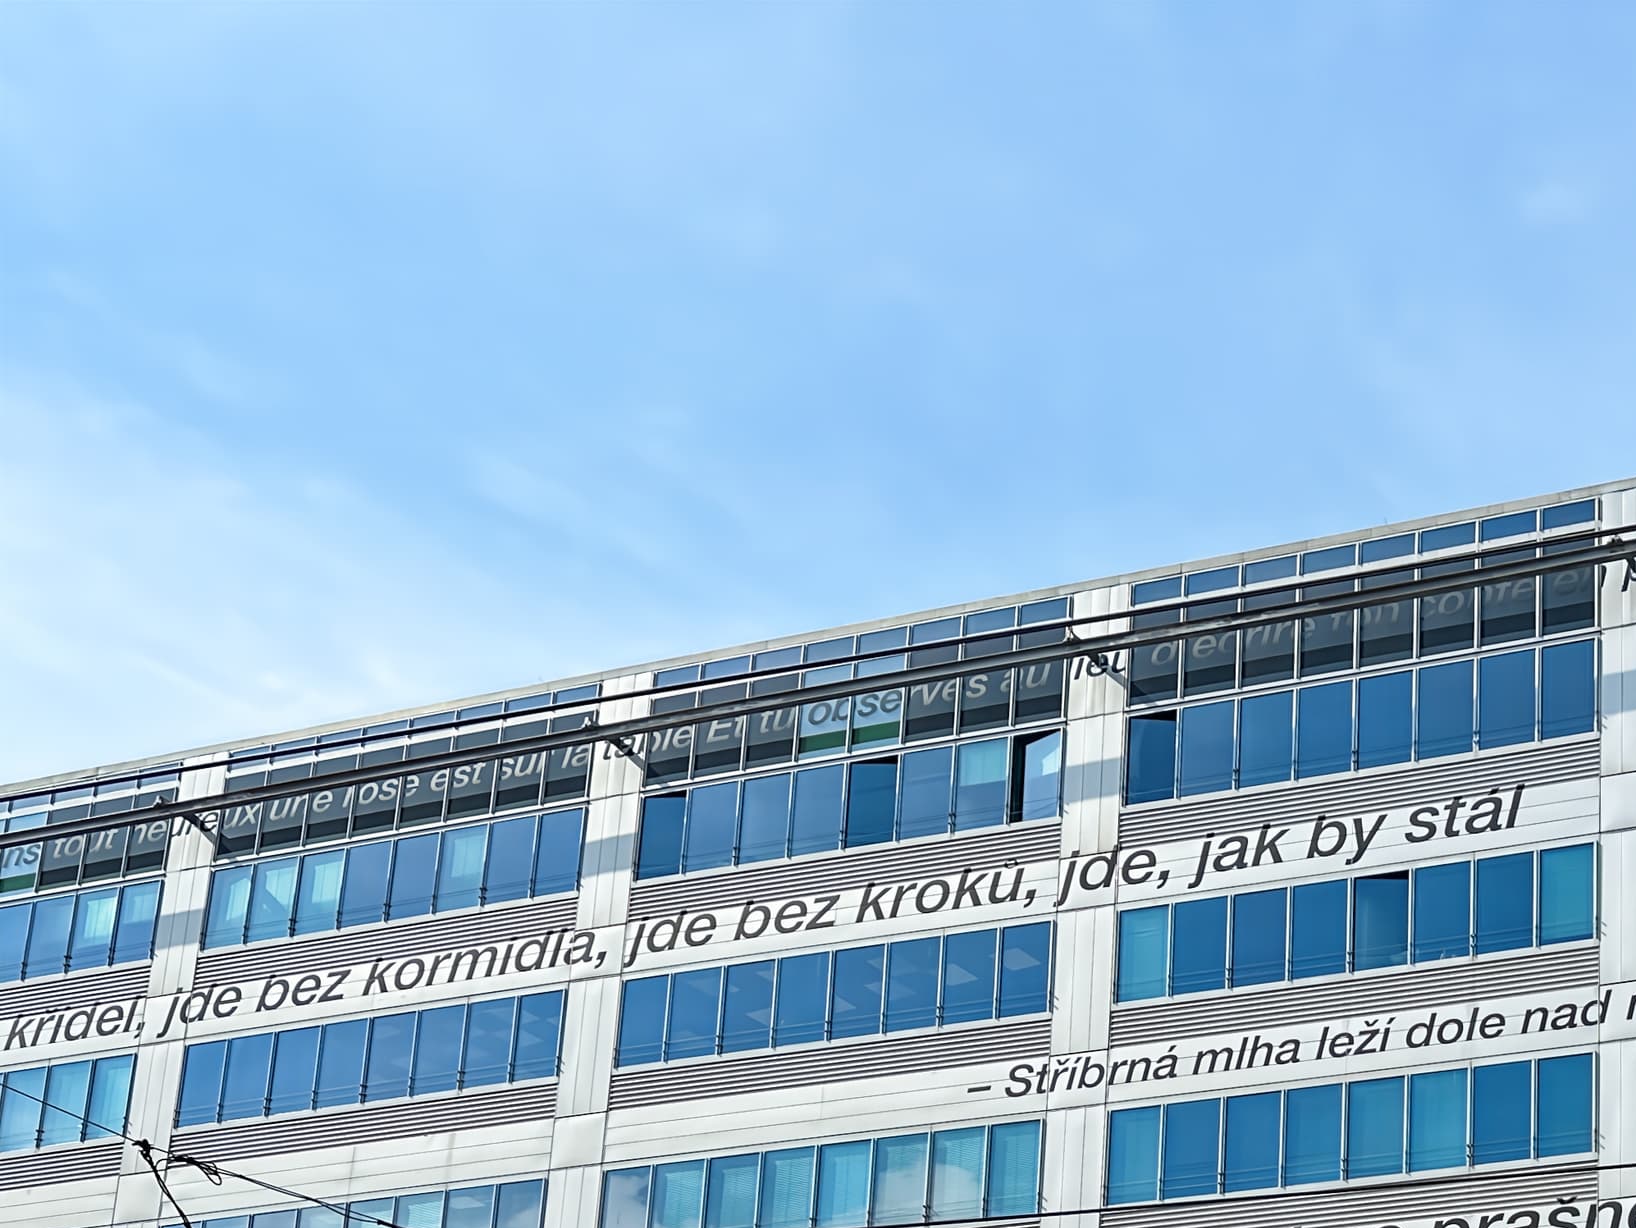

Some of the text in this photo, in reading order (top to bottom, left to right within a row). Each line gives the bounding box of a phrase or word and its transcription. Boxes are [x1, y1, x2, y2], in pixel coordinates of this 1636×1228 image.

[53, 827, 118, 859] tout
[269, 788, 333, 821] une
[343, 773, 419, 807] rose
[430, 761, 486, 791] est
[759, 706, 797, 733] tu
[1000, 661, 1050, 691] au
[156, 983, 243, 1038] jde
[255, 969, 352, 1013] bez
[362, 928, 608, 997] kormidla,
[623, 910, 717, 968] jde
[733, 894, 841, 939] bez
[855, 858, 1036, 924] kroků,
[1053, 843, 1169, 906] jde,
[1188, 823, 1290, 889] jak
[1306, 814, 1388, 866] by
[1404, 783, 1526, 844] stál
[1004, 1044, 1178, 1098] Stříbrná
[1192, 1035, 1301, 1076] mlha
[1315, 1016, 1396, 1060] leží
[1405, 1006, 1506, 1049] dole
[1520, 988, 1613, 1034] nad
